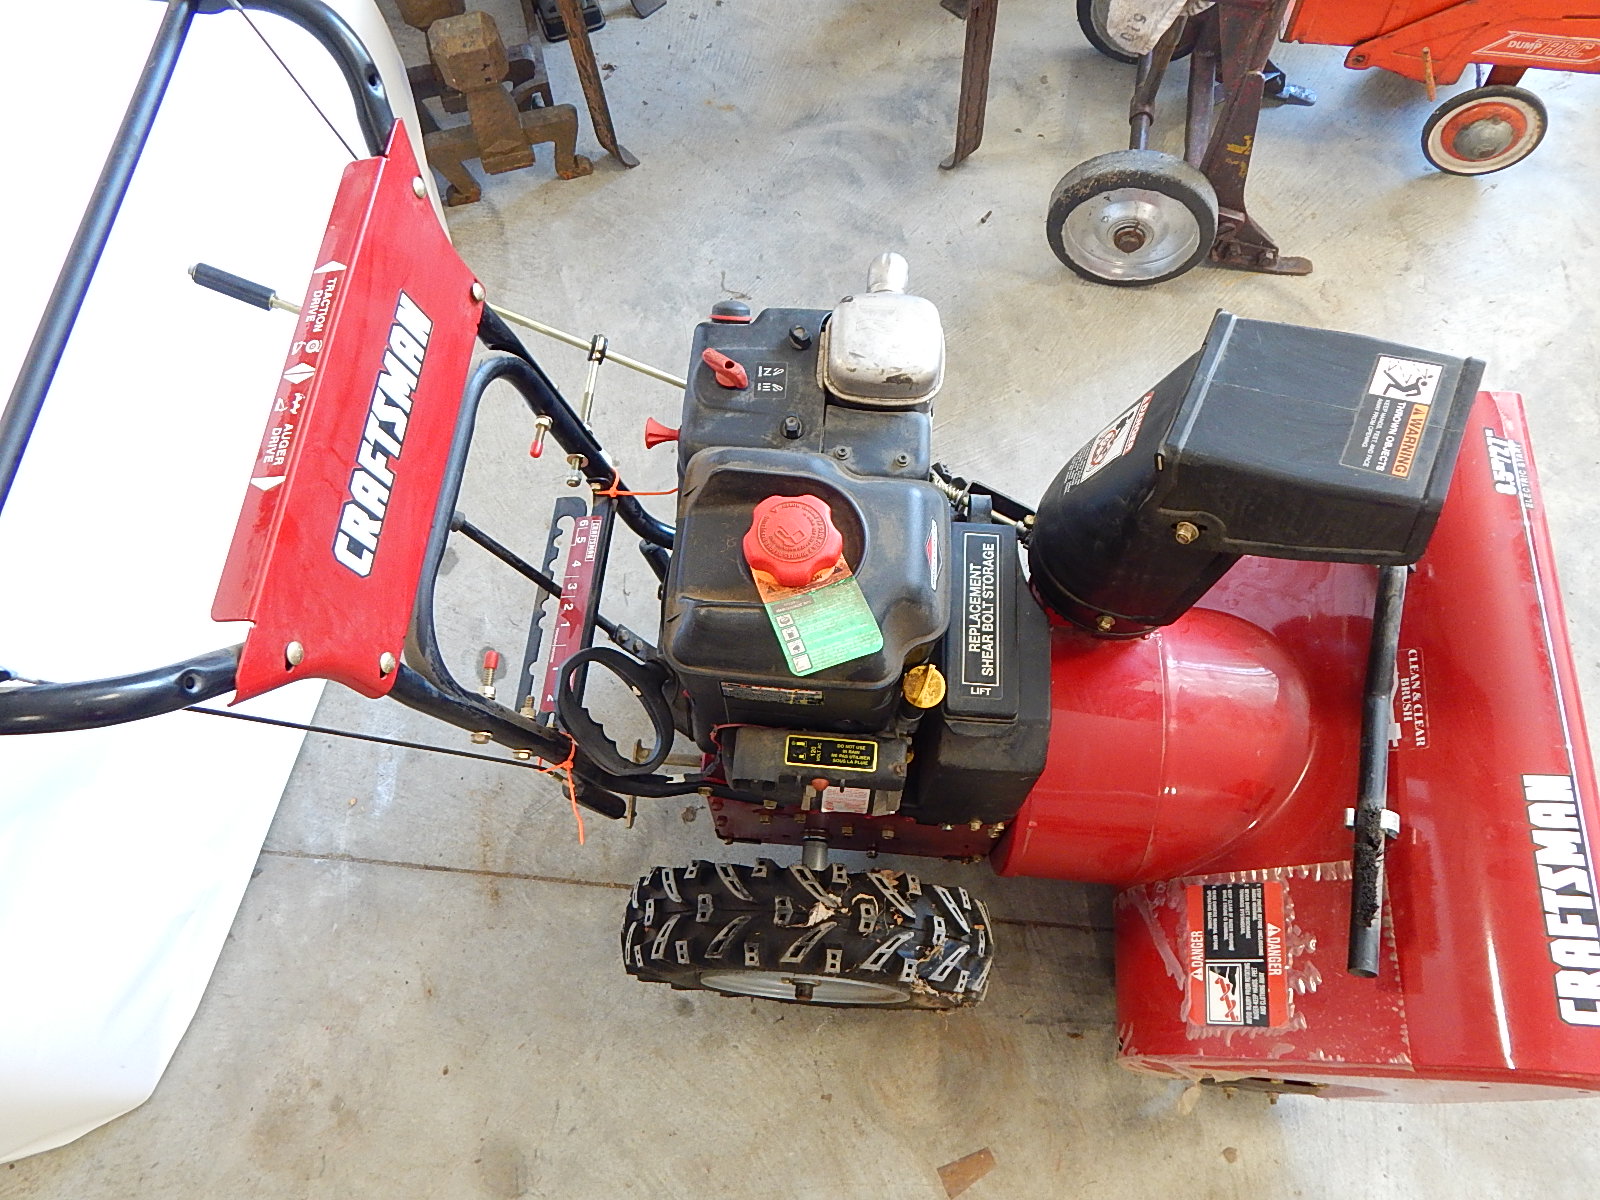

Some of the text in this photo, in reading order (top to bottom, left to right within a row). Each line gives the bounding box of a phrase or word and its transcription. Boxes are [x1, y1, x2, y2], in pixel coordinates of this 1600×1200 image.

[1507, 41, 1542, 50] DUMP
[305, 290, 319, 323] DRIVE
[313, 277, 338, 333] TRACTION
[263, 427, 283, 464] DRIVE
[272, 423, 294, 466] AUGER
[332, 289, 433, 578] CRAFTSMAN
[1375, 402, 1406, 471] THROWN OBJECTS
[1394, 418, 1423, 474] WARNING
[1519, 470, 1534, 509] ELECTRIC
[576, 535, 587, 544] 5
[579, 519, 589, 527] 6
[587, 522, 600, 559] CRAFTSMAN
[572, 560, 582, 568] 4
[567, 583, 578, 591] 3
[968, 563, 982, 653] REPLACEMENT
[982, 543, 995, 677] SHEAR BOLT STORAGE
[970, 686, 992, 696] LIFT
[1400, 677, 1413, 721] BRUSH
[1408, 649, 1426, 747] CLEAN & CLEAR
[1522, 774, 1600, 1027] CRAFTSMAN
[1190, 930, 1204, 968] DANGER
[1267, 936, 1283, 976] DANGER
